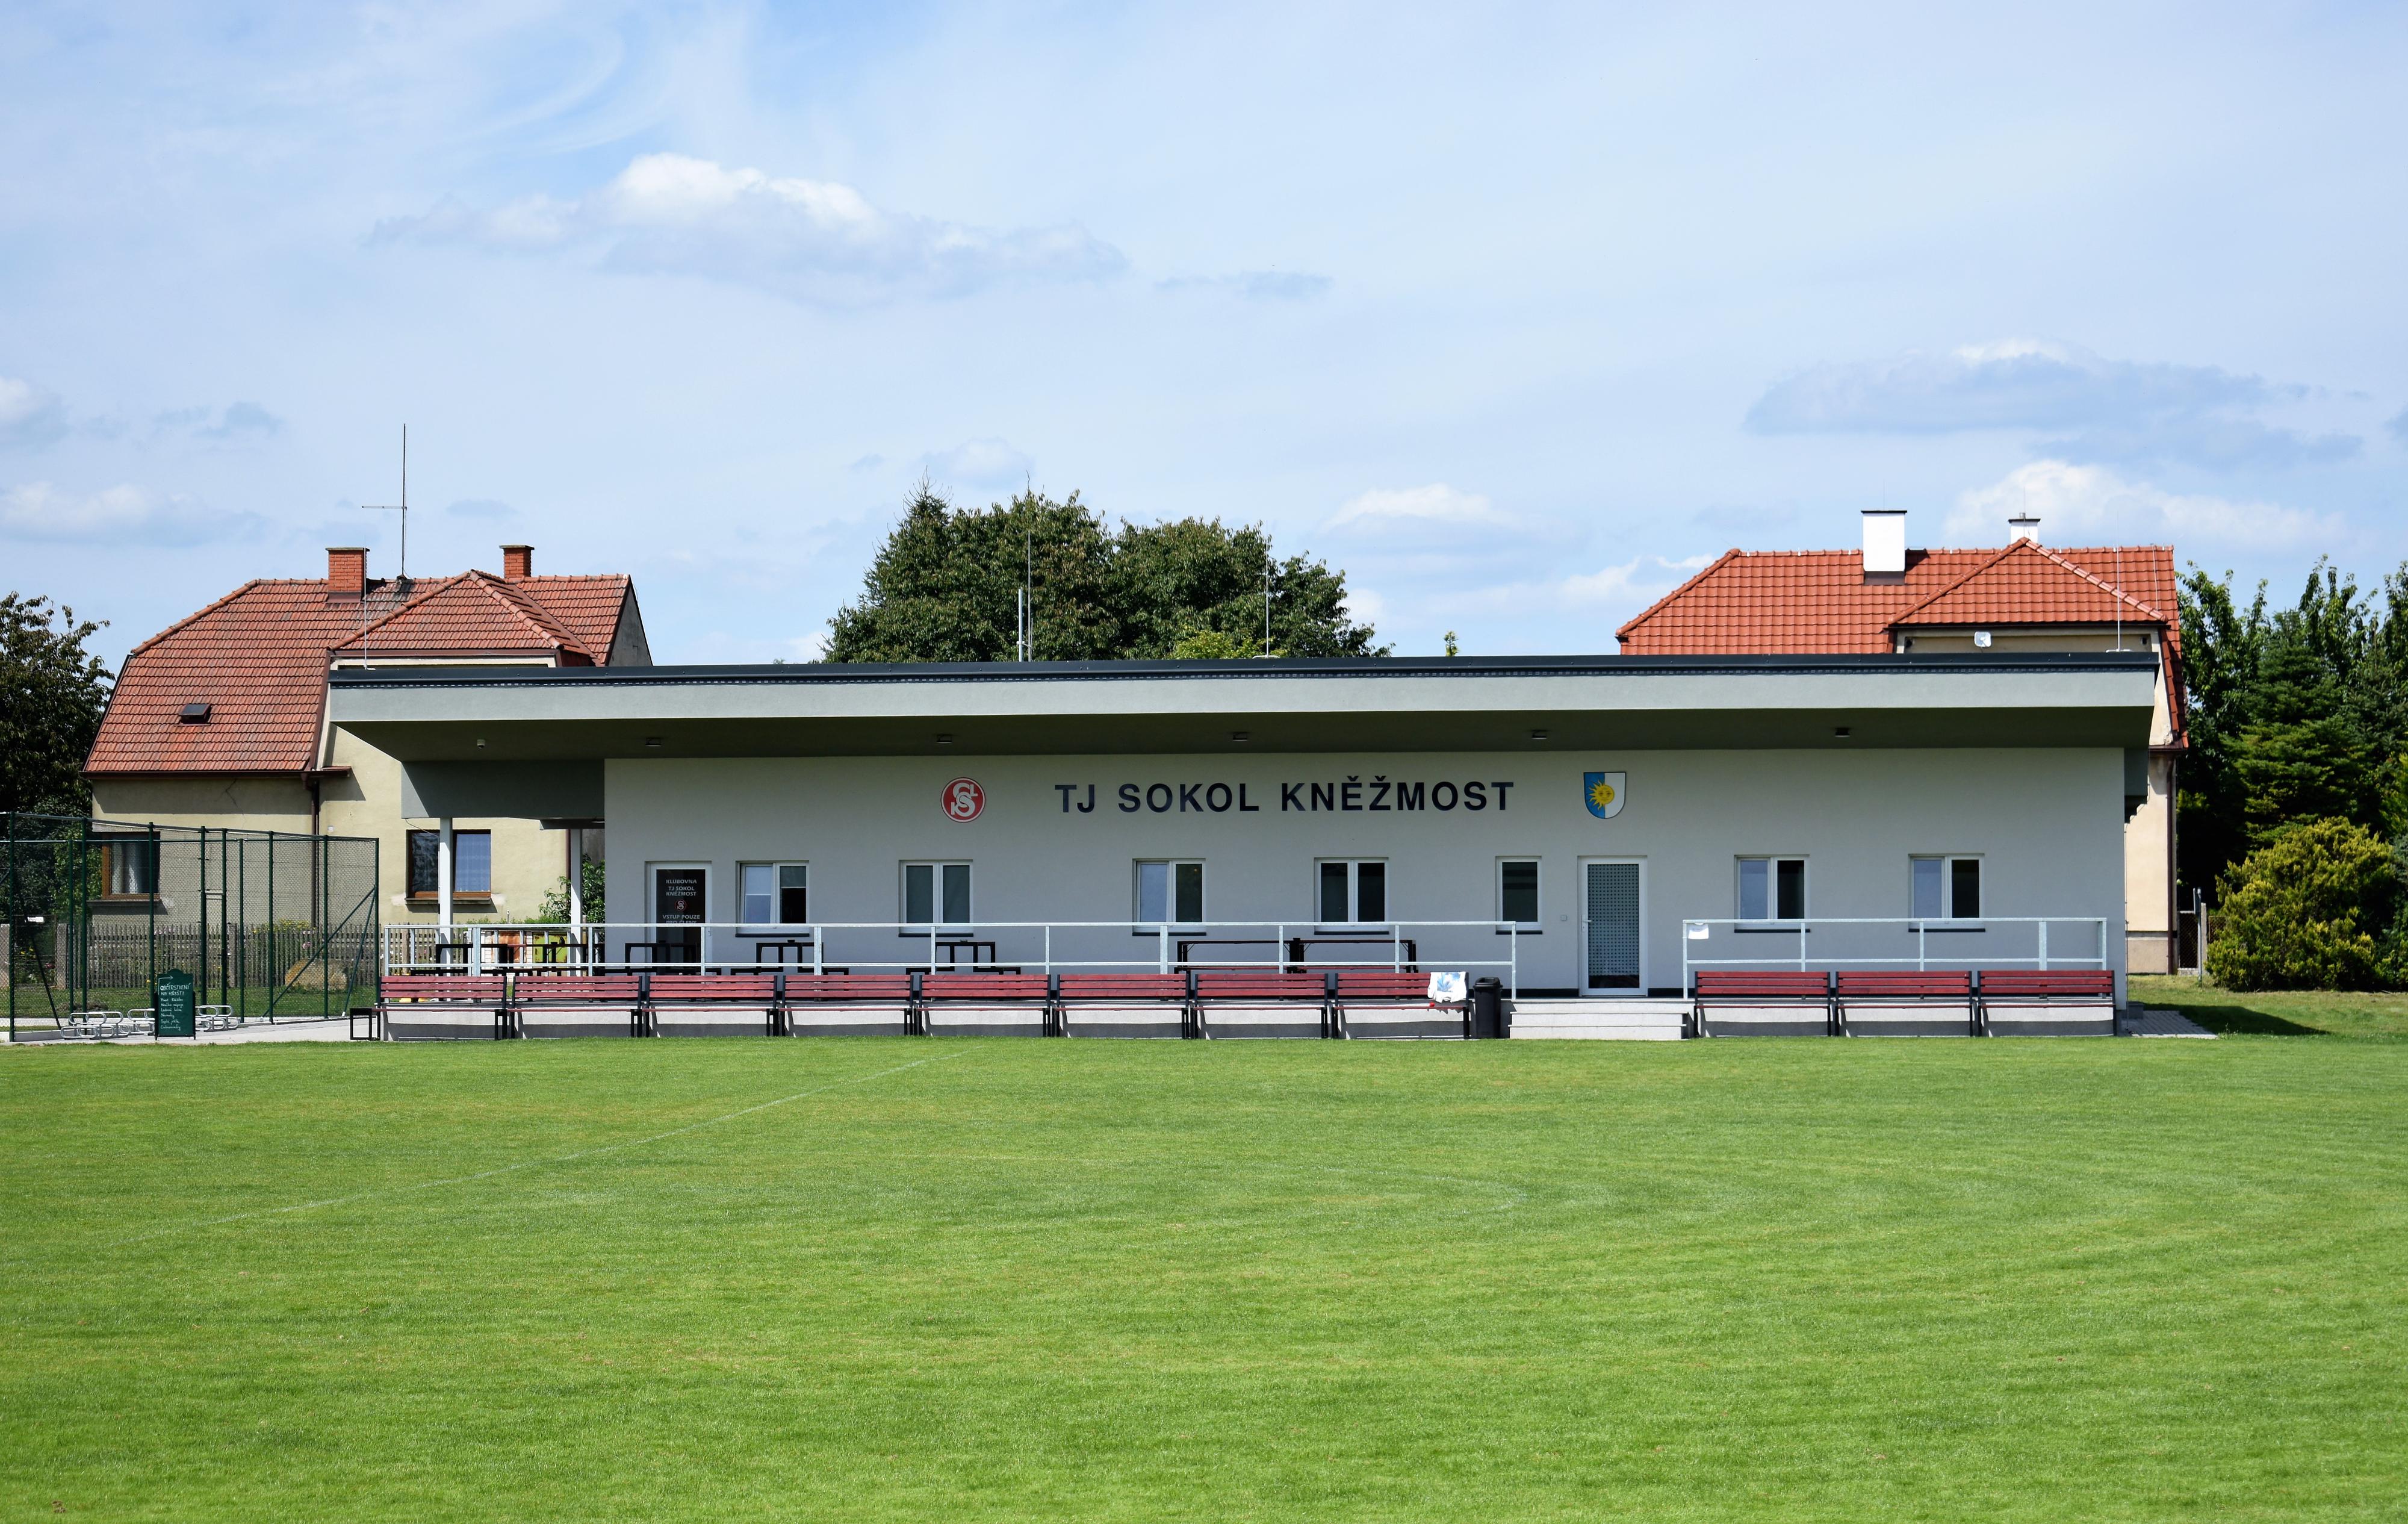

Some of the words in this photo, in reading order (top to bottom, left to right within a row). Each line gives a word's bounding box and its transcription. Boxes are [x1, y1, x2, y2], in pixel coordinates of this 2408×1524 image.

[1055, 784, 1095, 813] TJ
[1118, 783, 1259, 813] SOKOL
[1281, 776, 1514, 811] KNĚŽMOST
